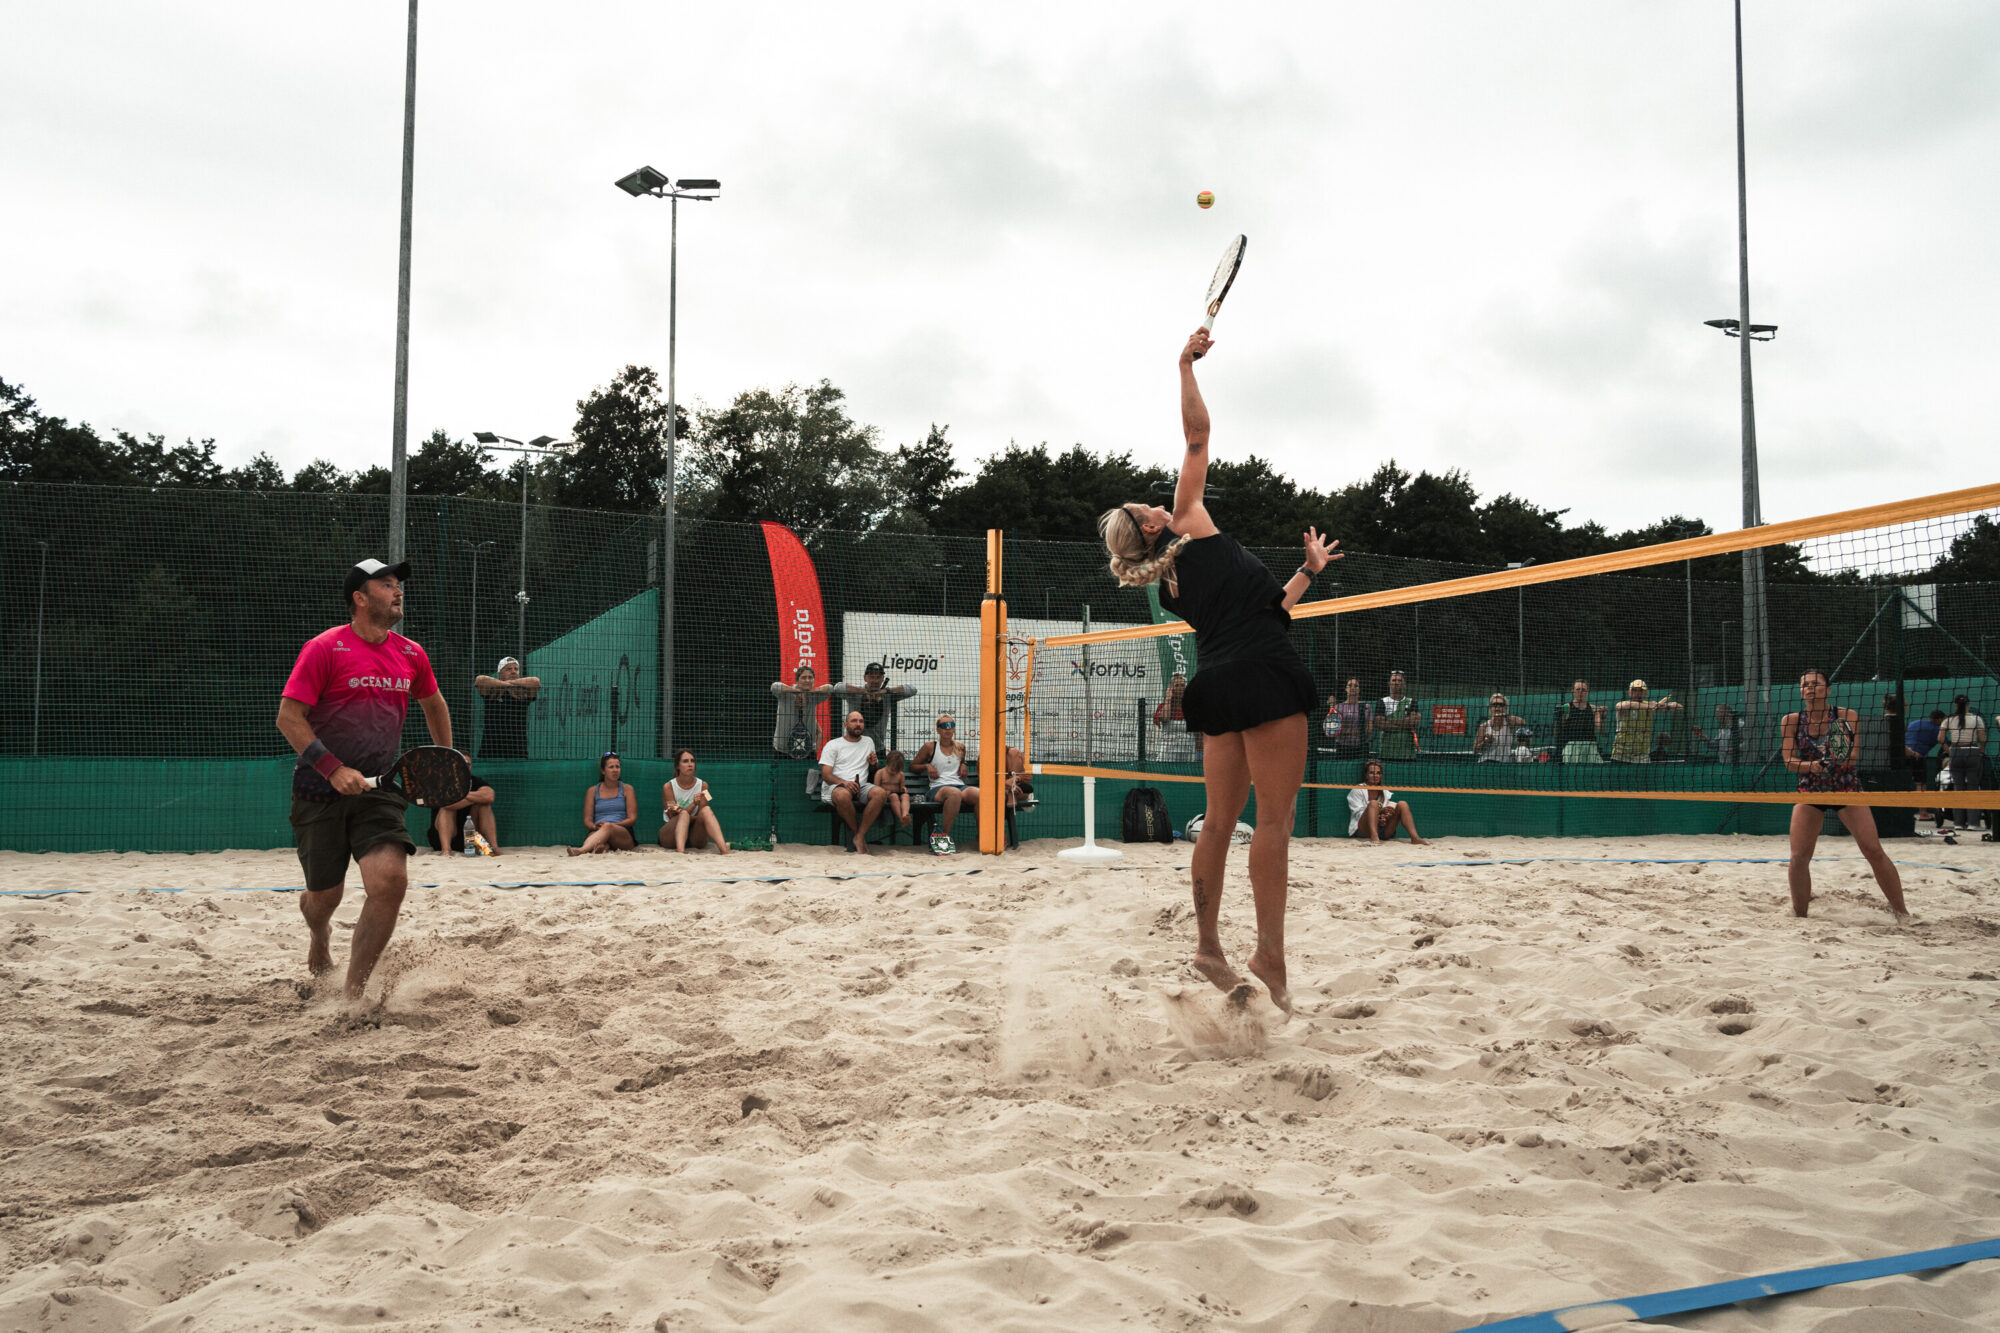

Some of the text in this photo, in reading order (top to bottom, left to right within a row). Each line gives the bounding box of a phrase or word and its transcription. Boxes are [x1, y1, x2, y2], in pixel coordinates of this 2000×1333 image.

[793, 609, 816, 674] epāja
[882, 653, 938, 673] Liepāja
[1089, 661, 1146, 678] fortius
[348, 675, 392, 689] OCEAN
